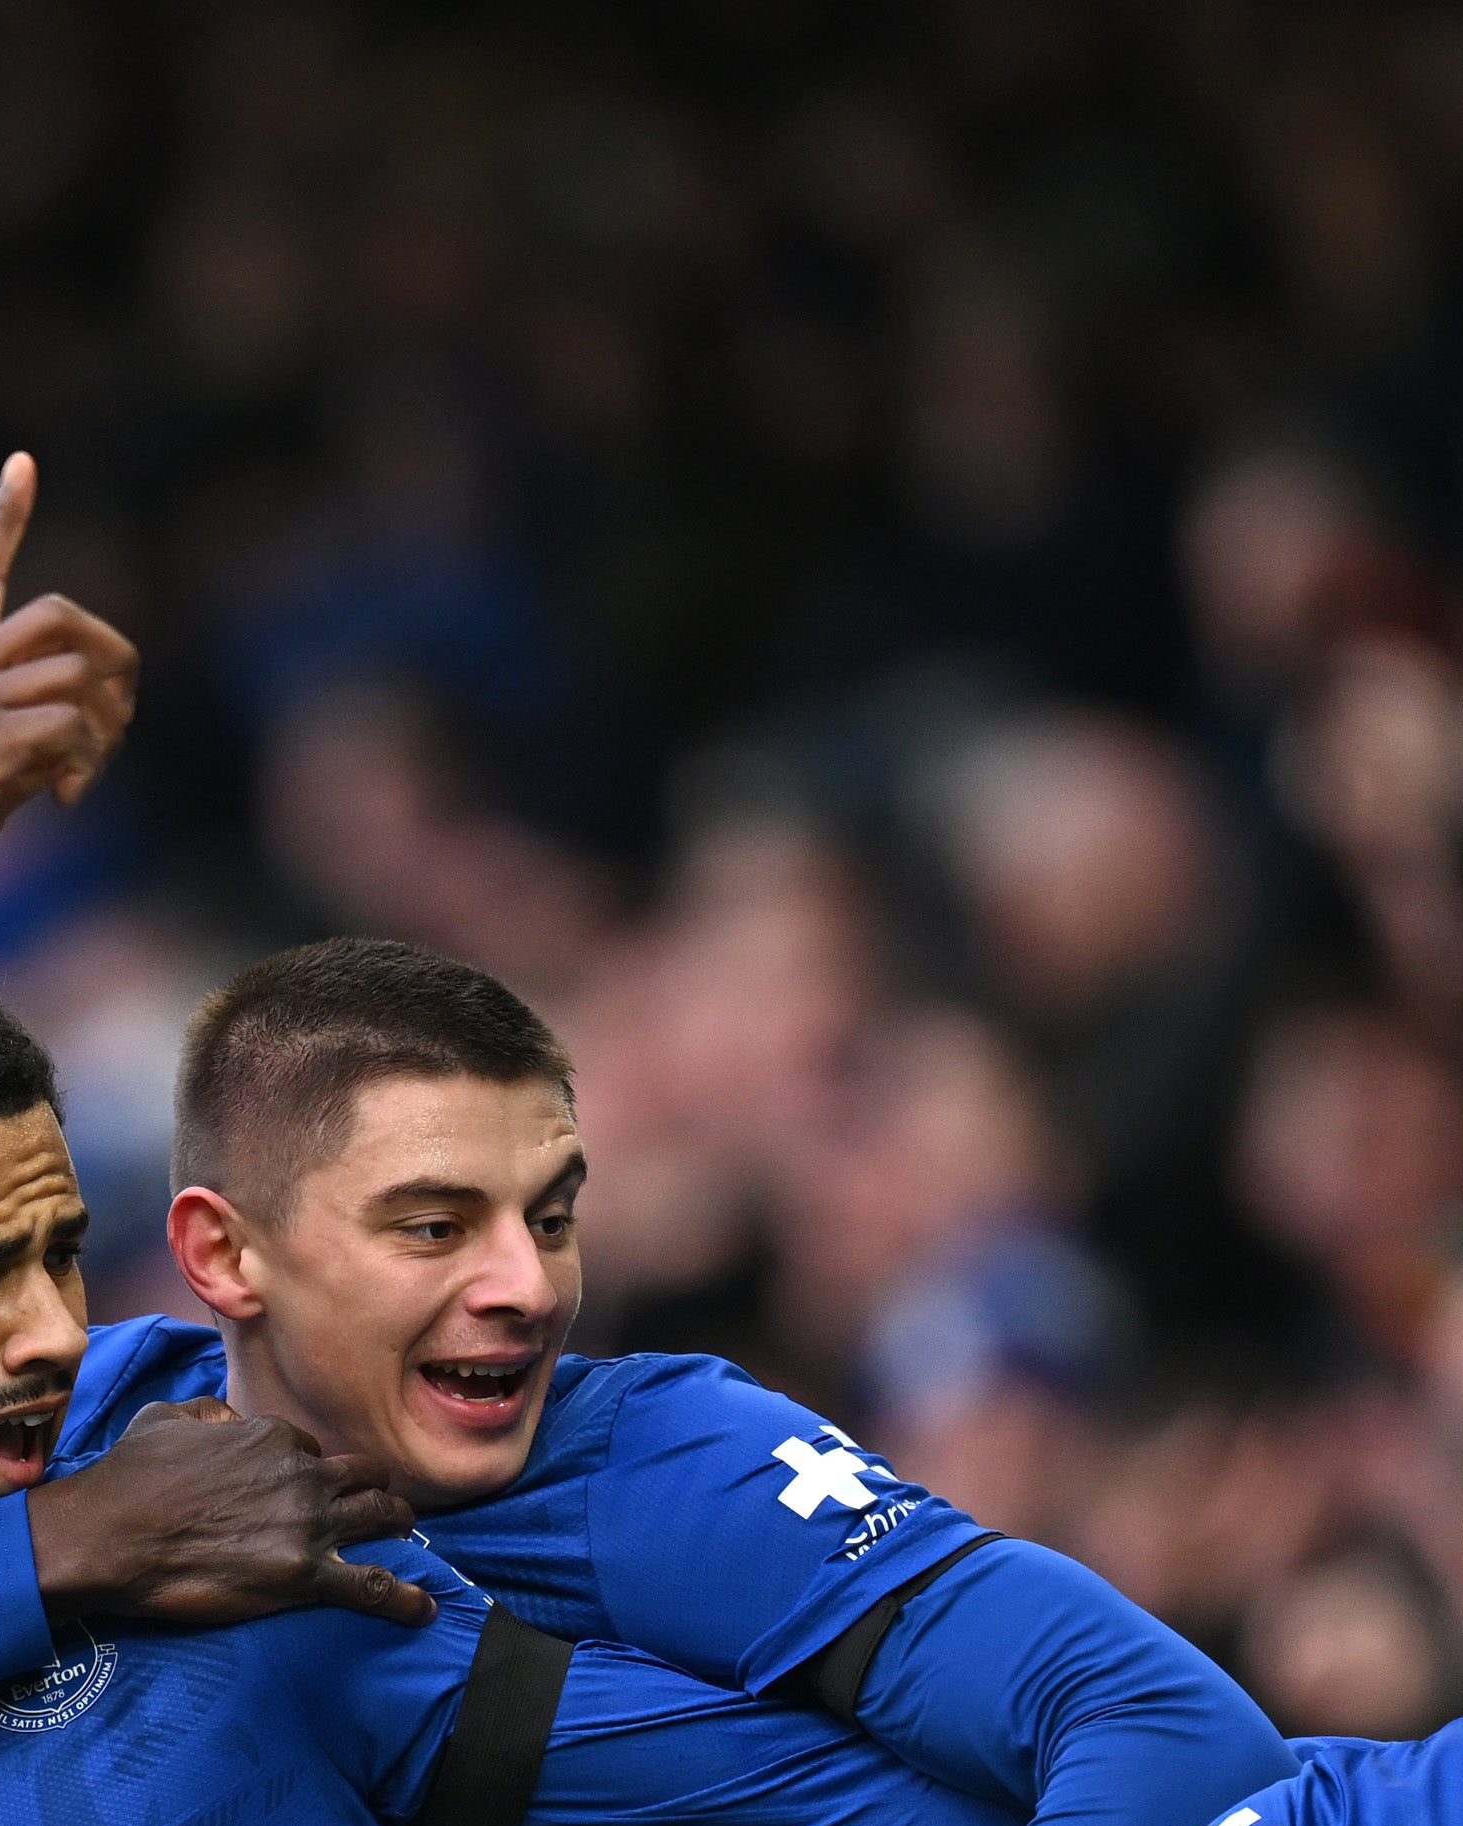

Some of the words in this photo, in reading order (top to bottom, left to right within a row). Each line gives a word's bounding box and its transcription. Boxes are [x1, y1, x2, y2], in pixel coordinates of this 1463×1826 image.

[10, 1662, 87, 1701] Everton
[11, 1718, 44, 1729] SATIS
[48, 1709, 75, 1726] NISI
[75, 1661, 113, 1711] OPTIMUM
[40, 1688, 65, 1704] 1878
